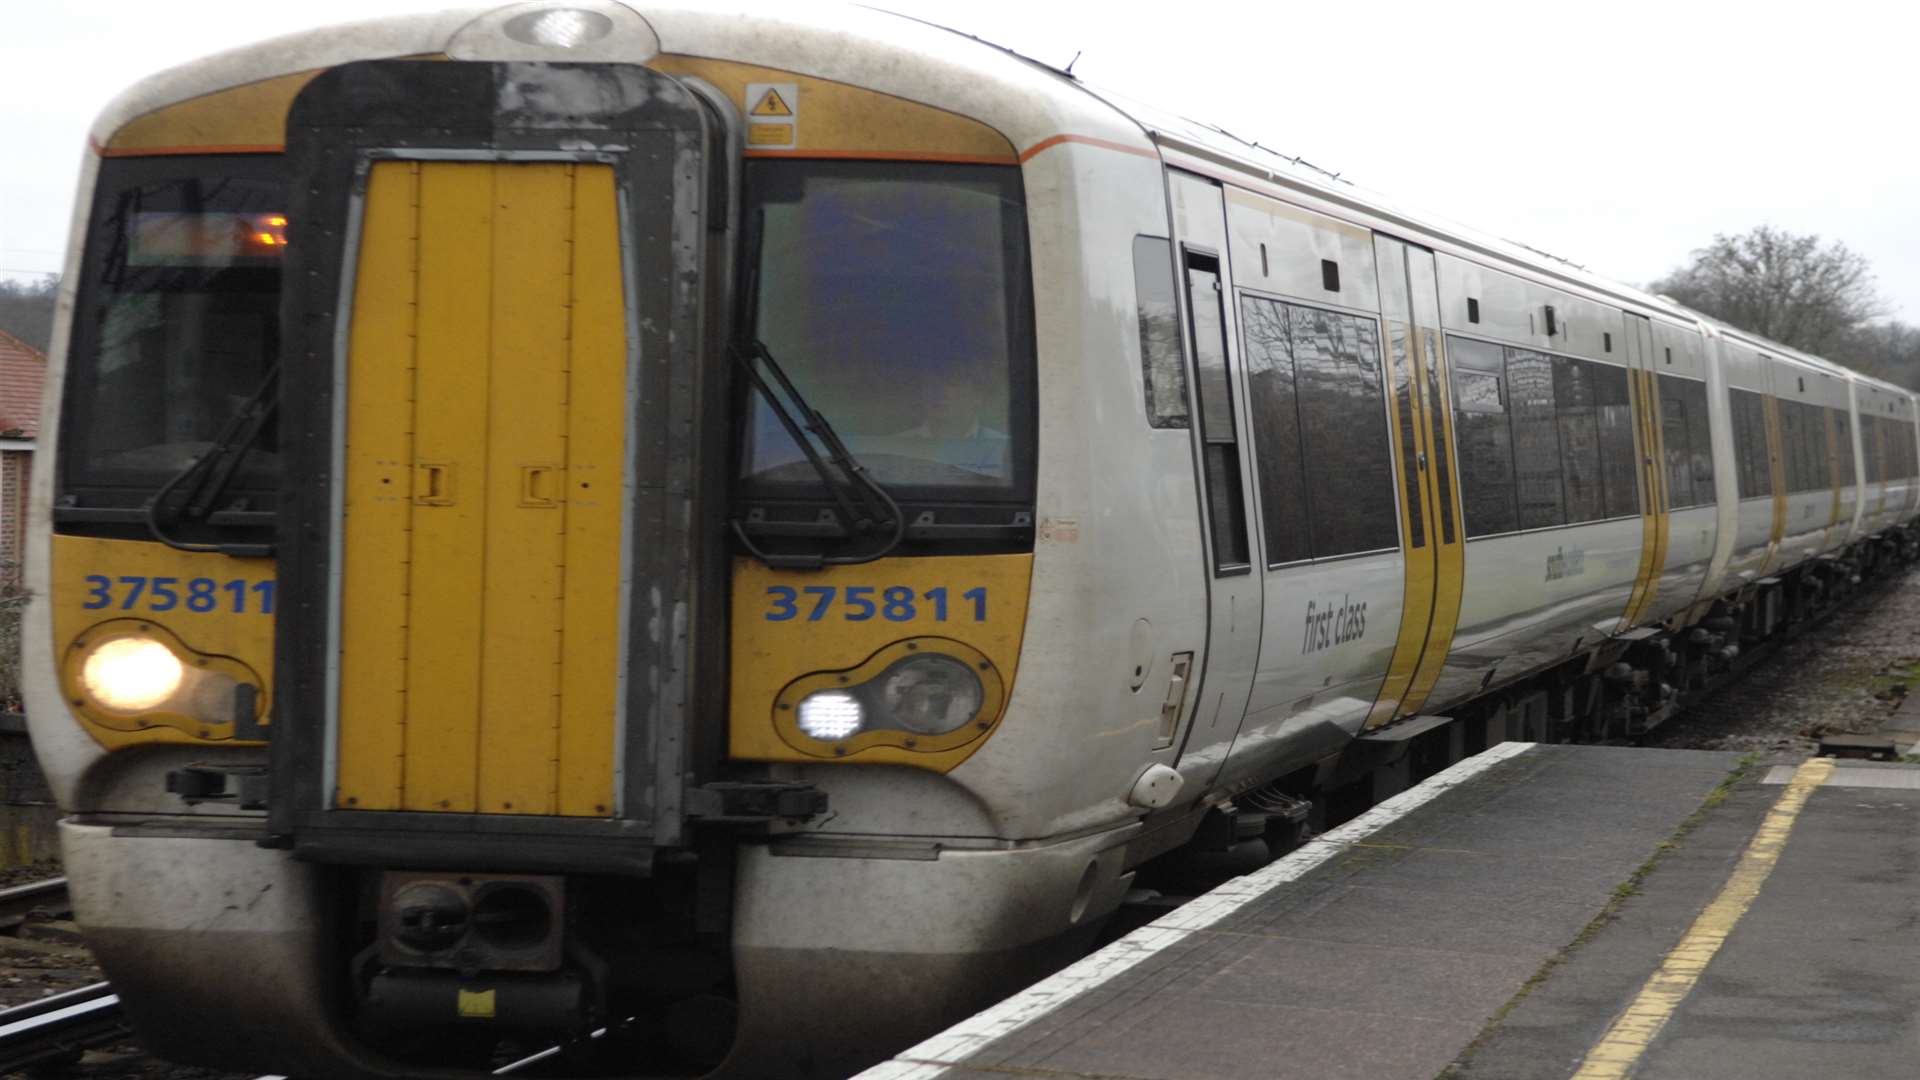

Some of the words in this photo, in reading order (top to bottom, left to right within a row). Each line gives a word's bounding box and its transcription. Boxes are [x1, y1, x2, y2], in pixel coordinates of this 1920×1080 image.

[83, 575, 277, 613] 375811
[765, 586, 988, 622] 375811
[1302, 600, 1334, 655] first
[1335, 593, 1367, 645] class
